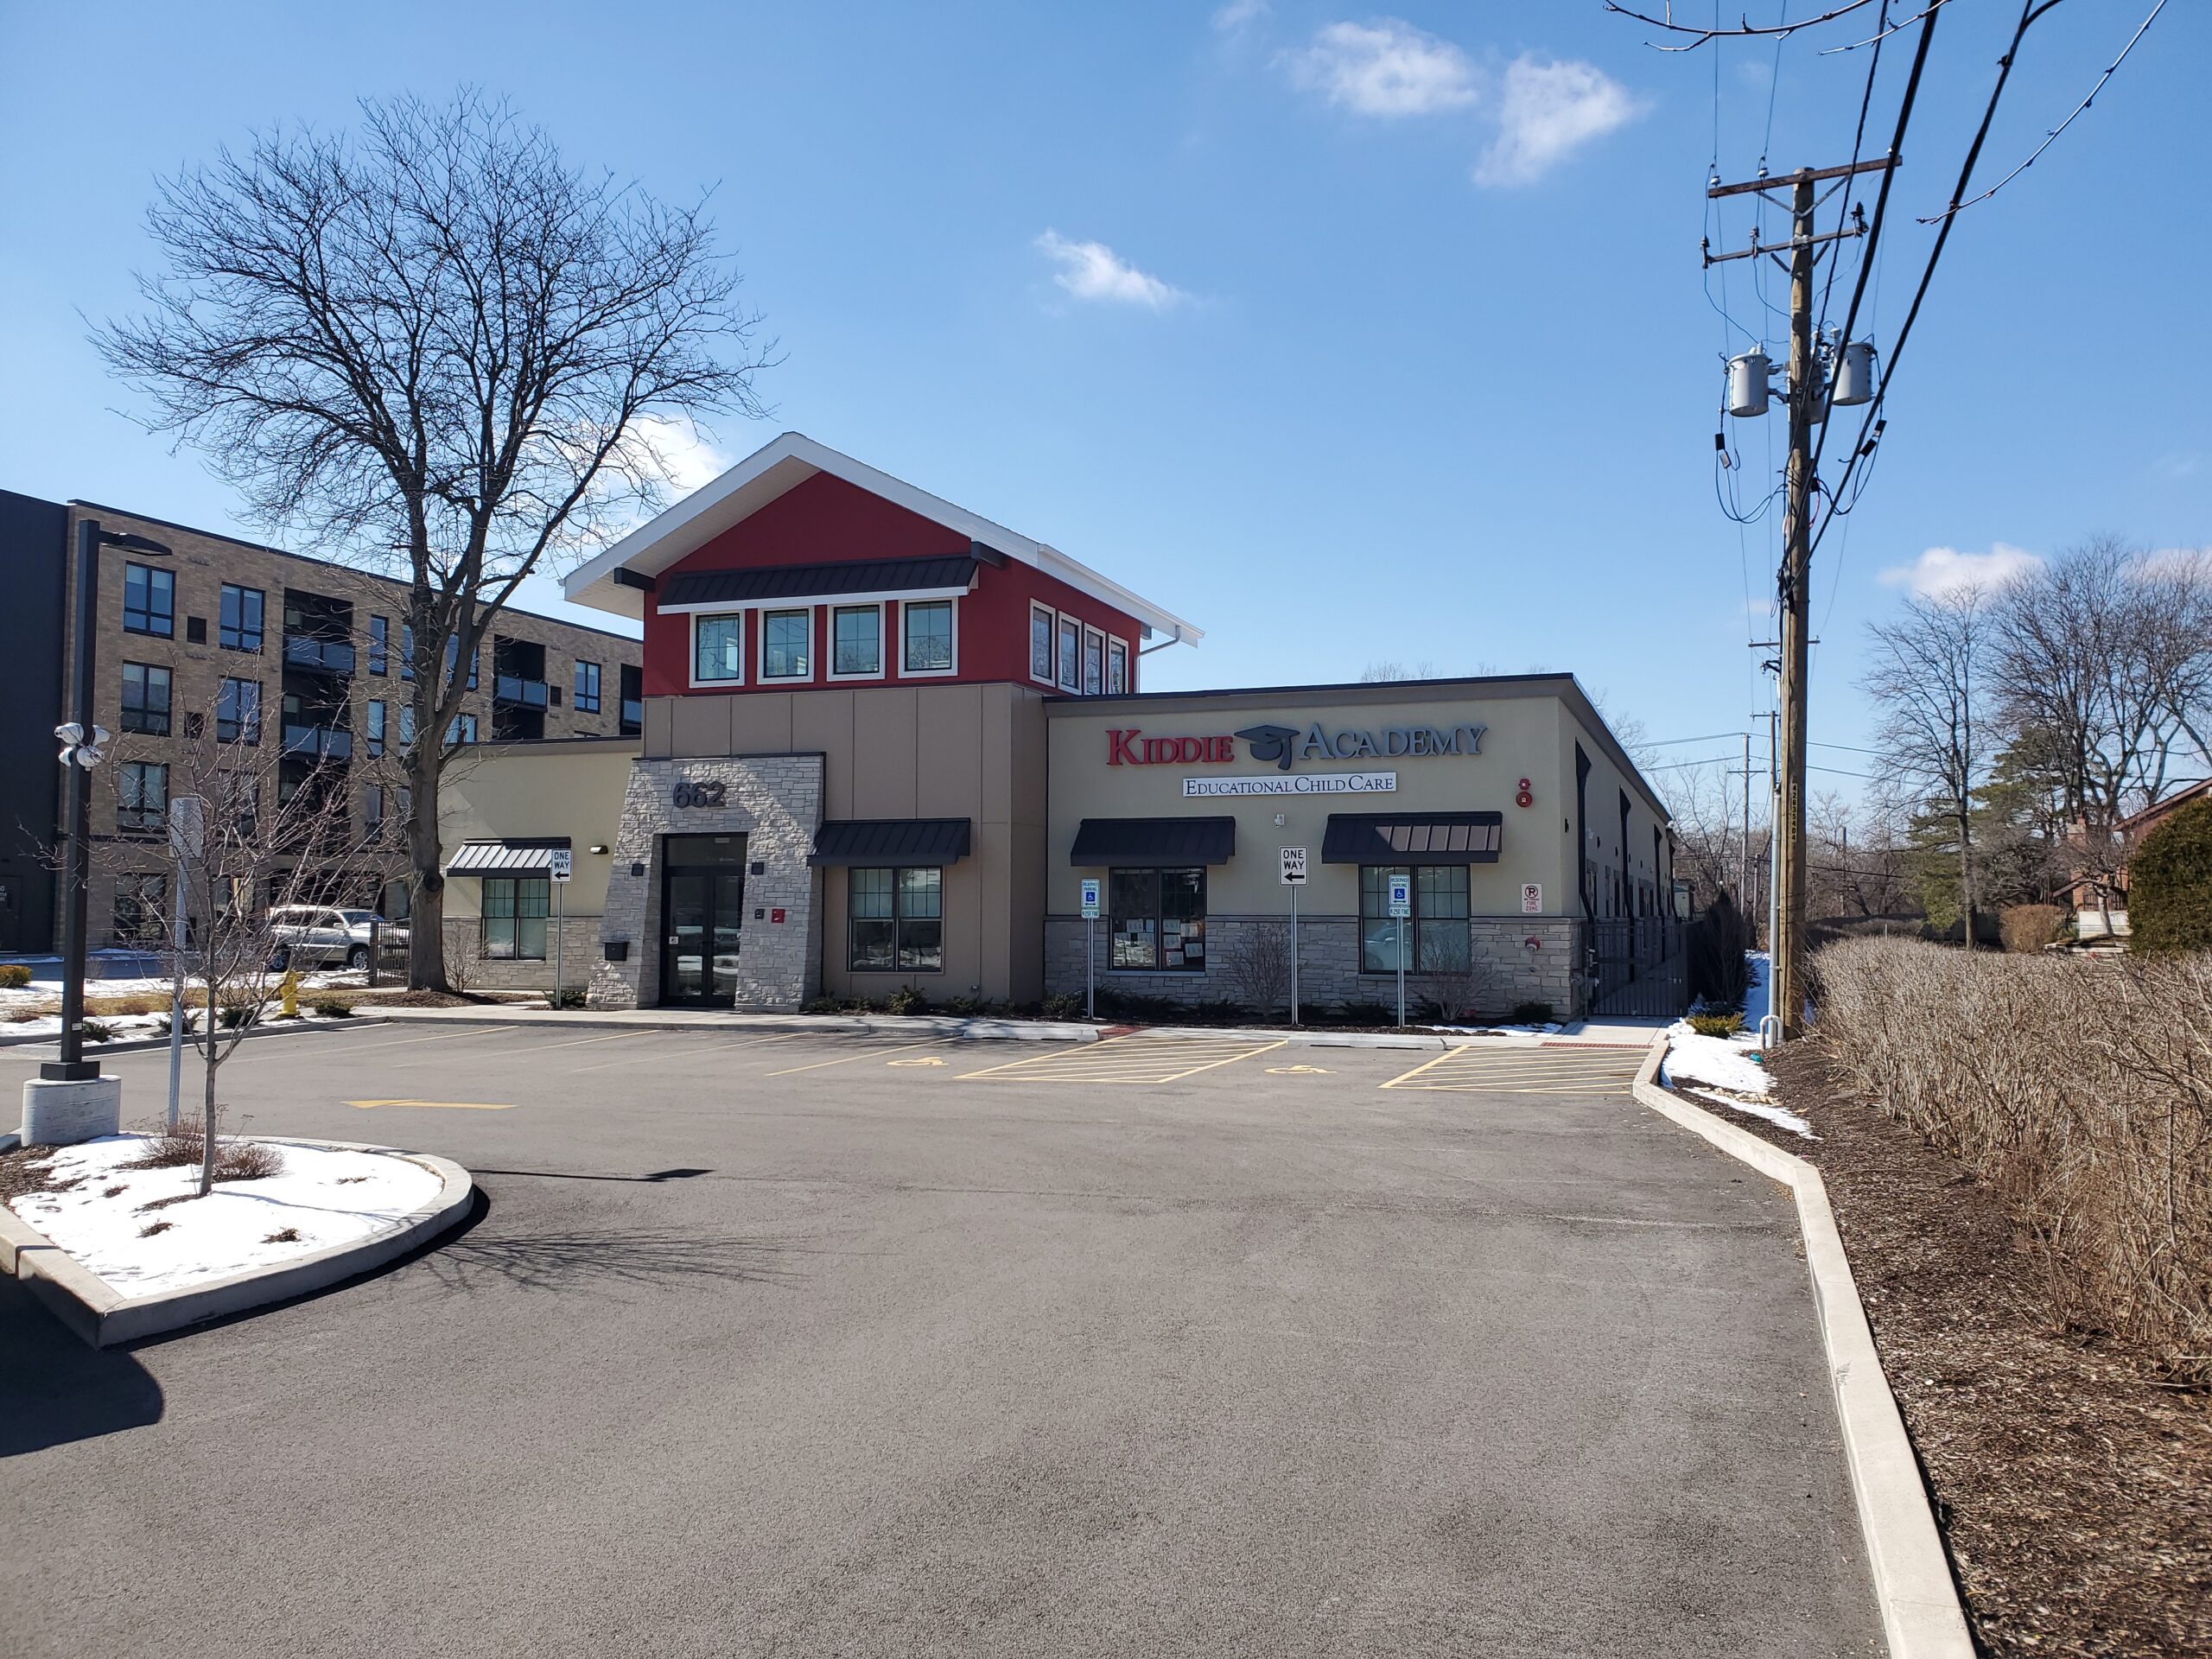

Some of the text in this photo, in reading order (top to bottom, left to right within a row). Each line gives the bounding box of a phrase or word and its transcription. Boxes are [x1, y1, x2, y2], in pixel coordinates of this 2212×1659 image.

[1106, 721, 1489, 766] KIDDIE ACADEMY
[1185, 779, 1293, 795] EDUCATIONAL
[673, 781, 725, 808] 662
[554, 851, 569, 860] ONE
[1283, 849, 1304, 859] ONE
[554, 861, 570, 869] WAY
[1283, 860, 1305, 869] WAY
